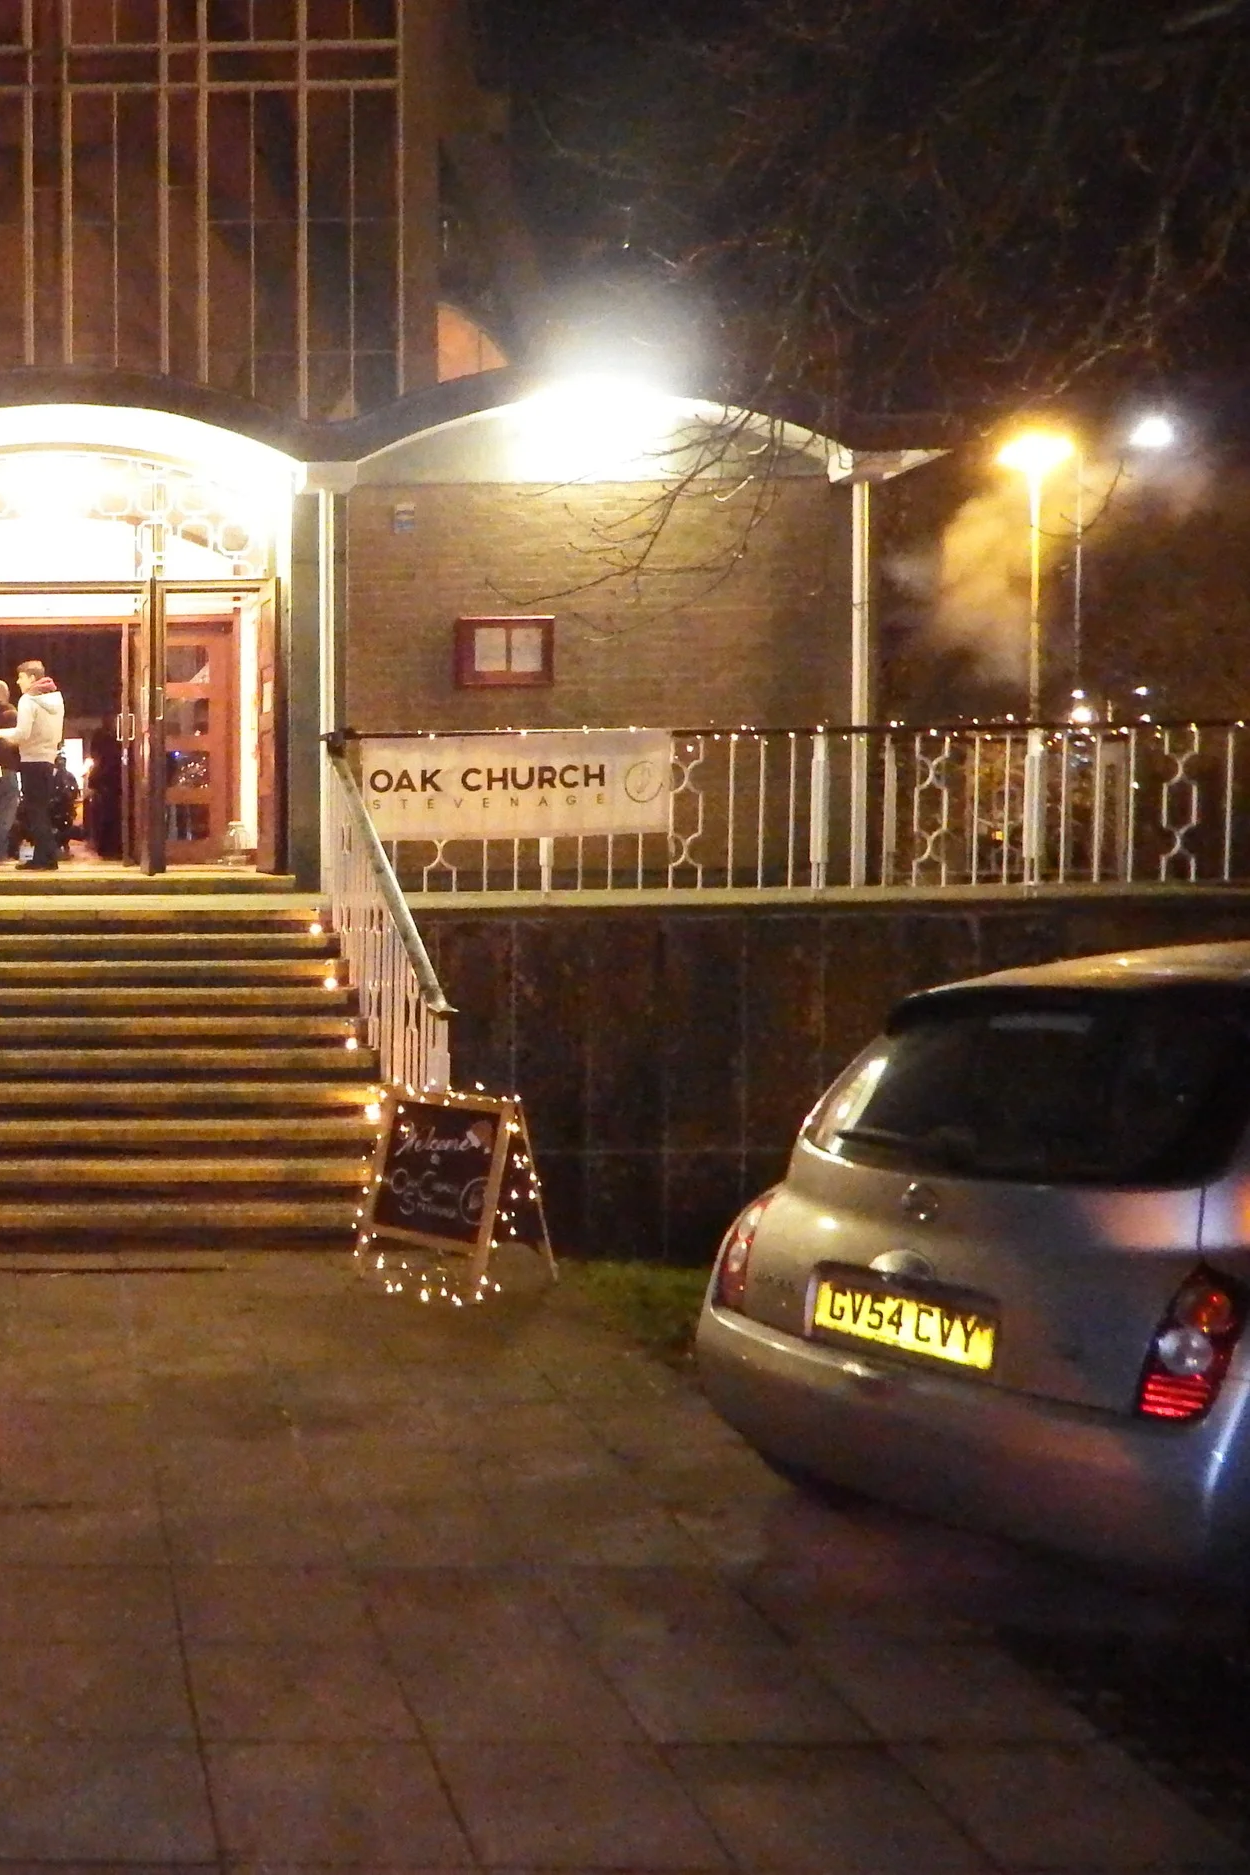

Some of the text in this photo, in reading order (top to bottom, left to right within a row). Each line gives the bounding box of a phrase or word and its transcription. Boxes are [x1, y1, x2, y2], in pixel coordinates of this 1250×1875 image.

[369, 764, 606, 793] OAK CHURCH
[373, 794, 605, 810] STEVENAGE
[829, 1288, 977, 1353] GV54 CVY
